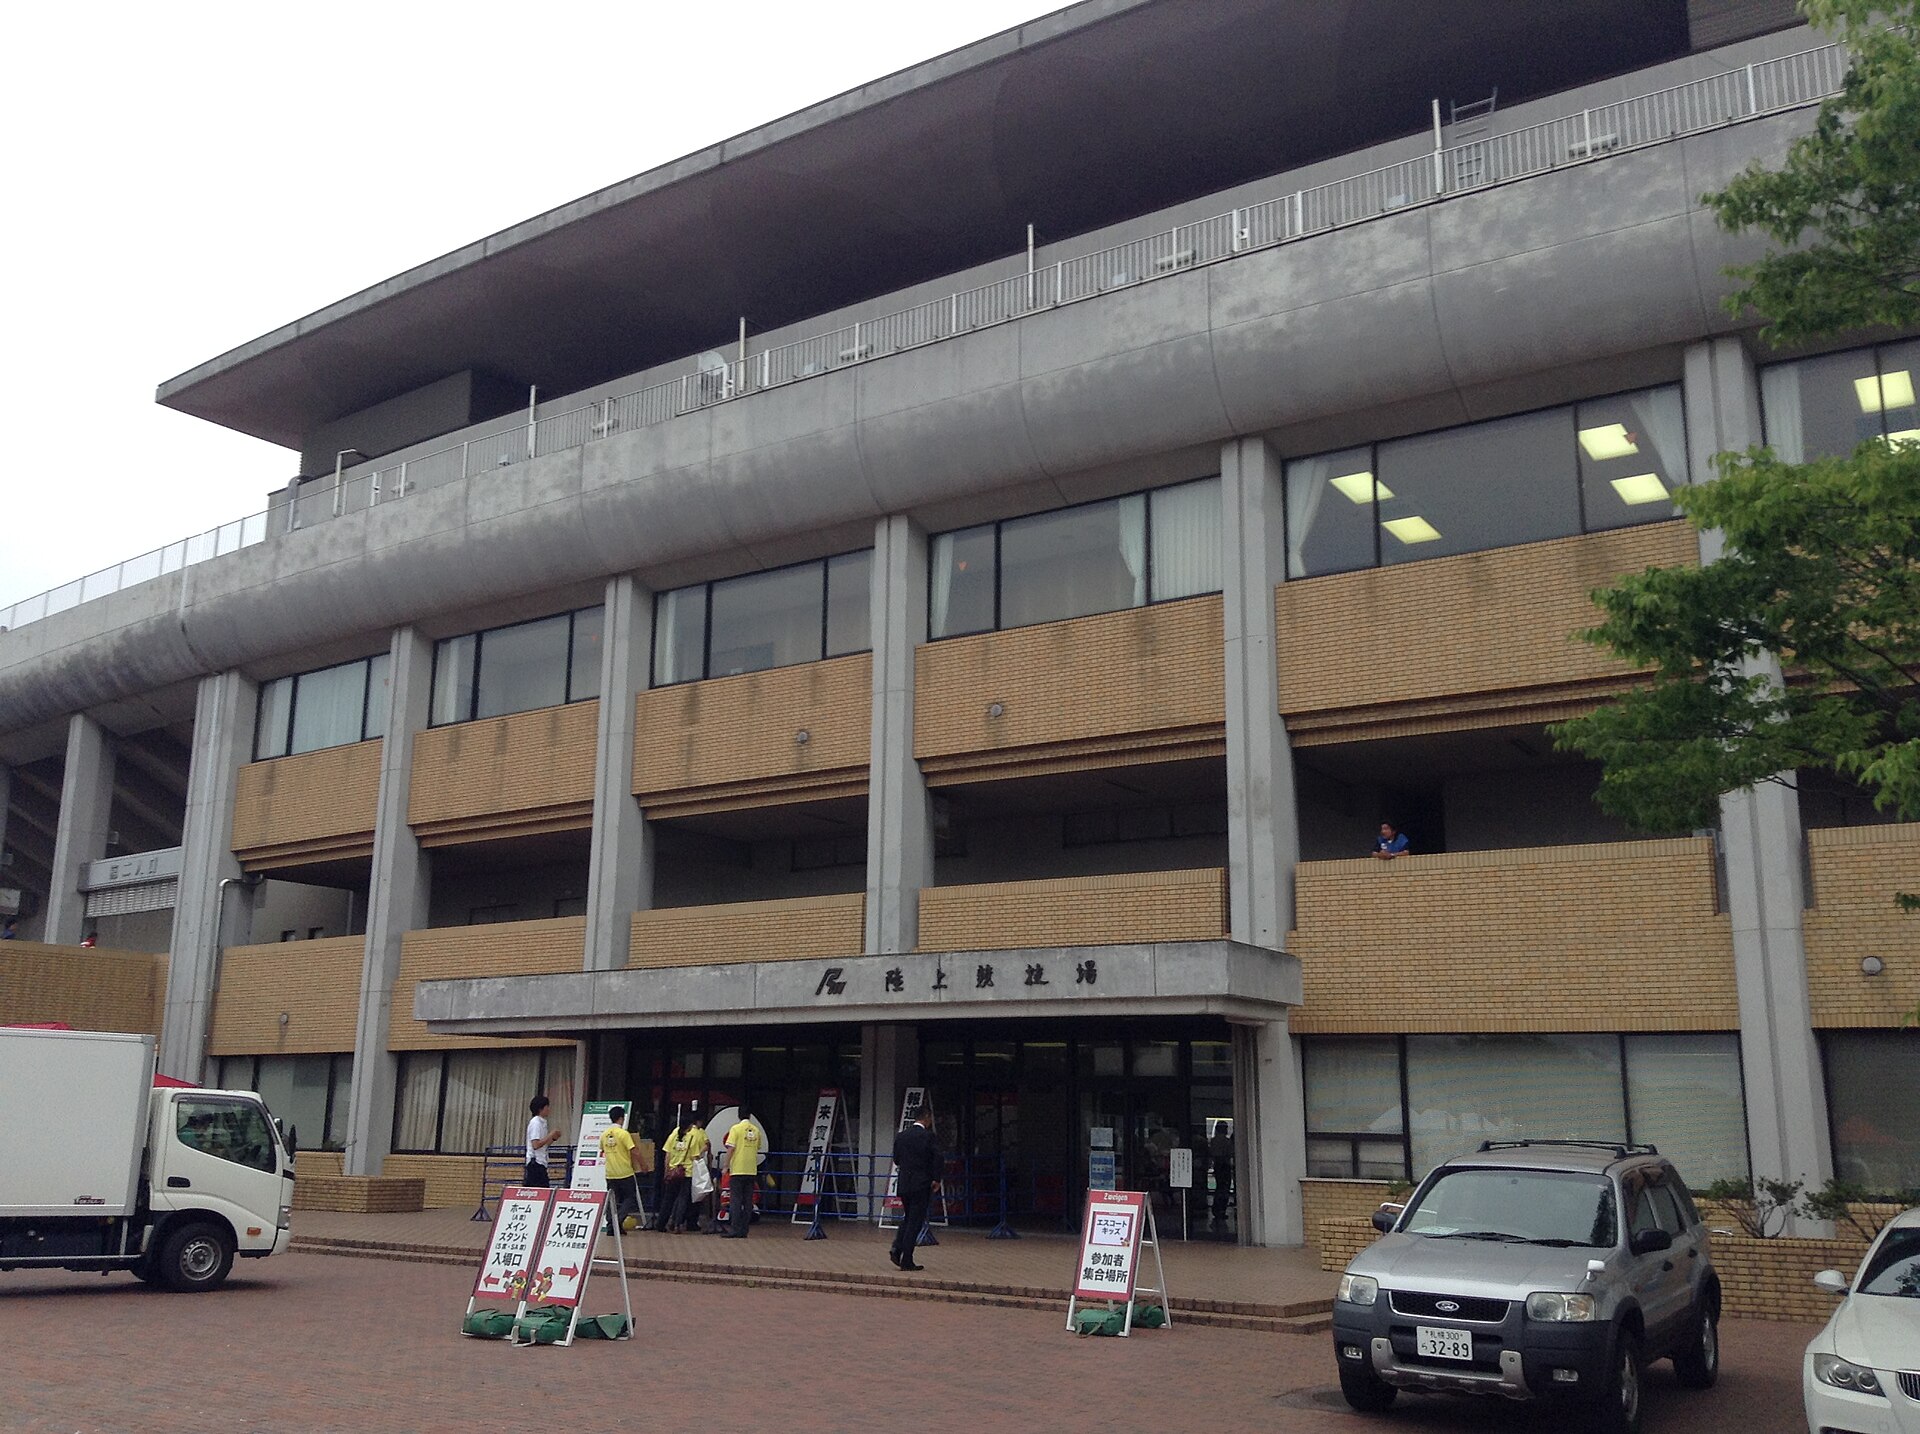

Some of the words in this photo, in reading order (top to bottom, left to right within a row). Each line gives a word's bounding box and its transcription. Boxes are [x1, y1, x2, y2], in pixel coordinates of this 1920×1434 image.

[510, 1203, 532, 1214] ホーム
[556, 1206, 594, 1221] アウェイ
[505, 1222, 528, 1232] メイン
[1097, 1218, 1128, 1228] エスコート
[498, 1231, 528, 1243] スタンド
[552, 1223, 588, 1240] 入場口
[1101, 1227, 1121, 1235] キッズ
[491, 1252, 523, 1267] 入場口
[1091, 1252, 1125, 1268] 参加者
[1082, 1267, 1129, 1284] 集合場所
[1446, 1332, 1459, 1340] 300
[1429, 1340, 1470, 1358] 32-89
